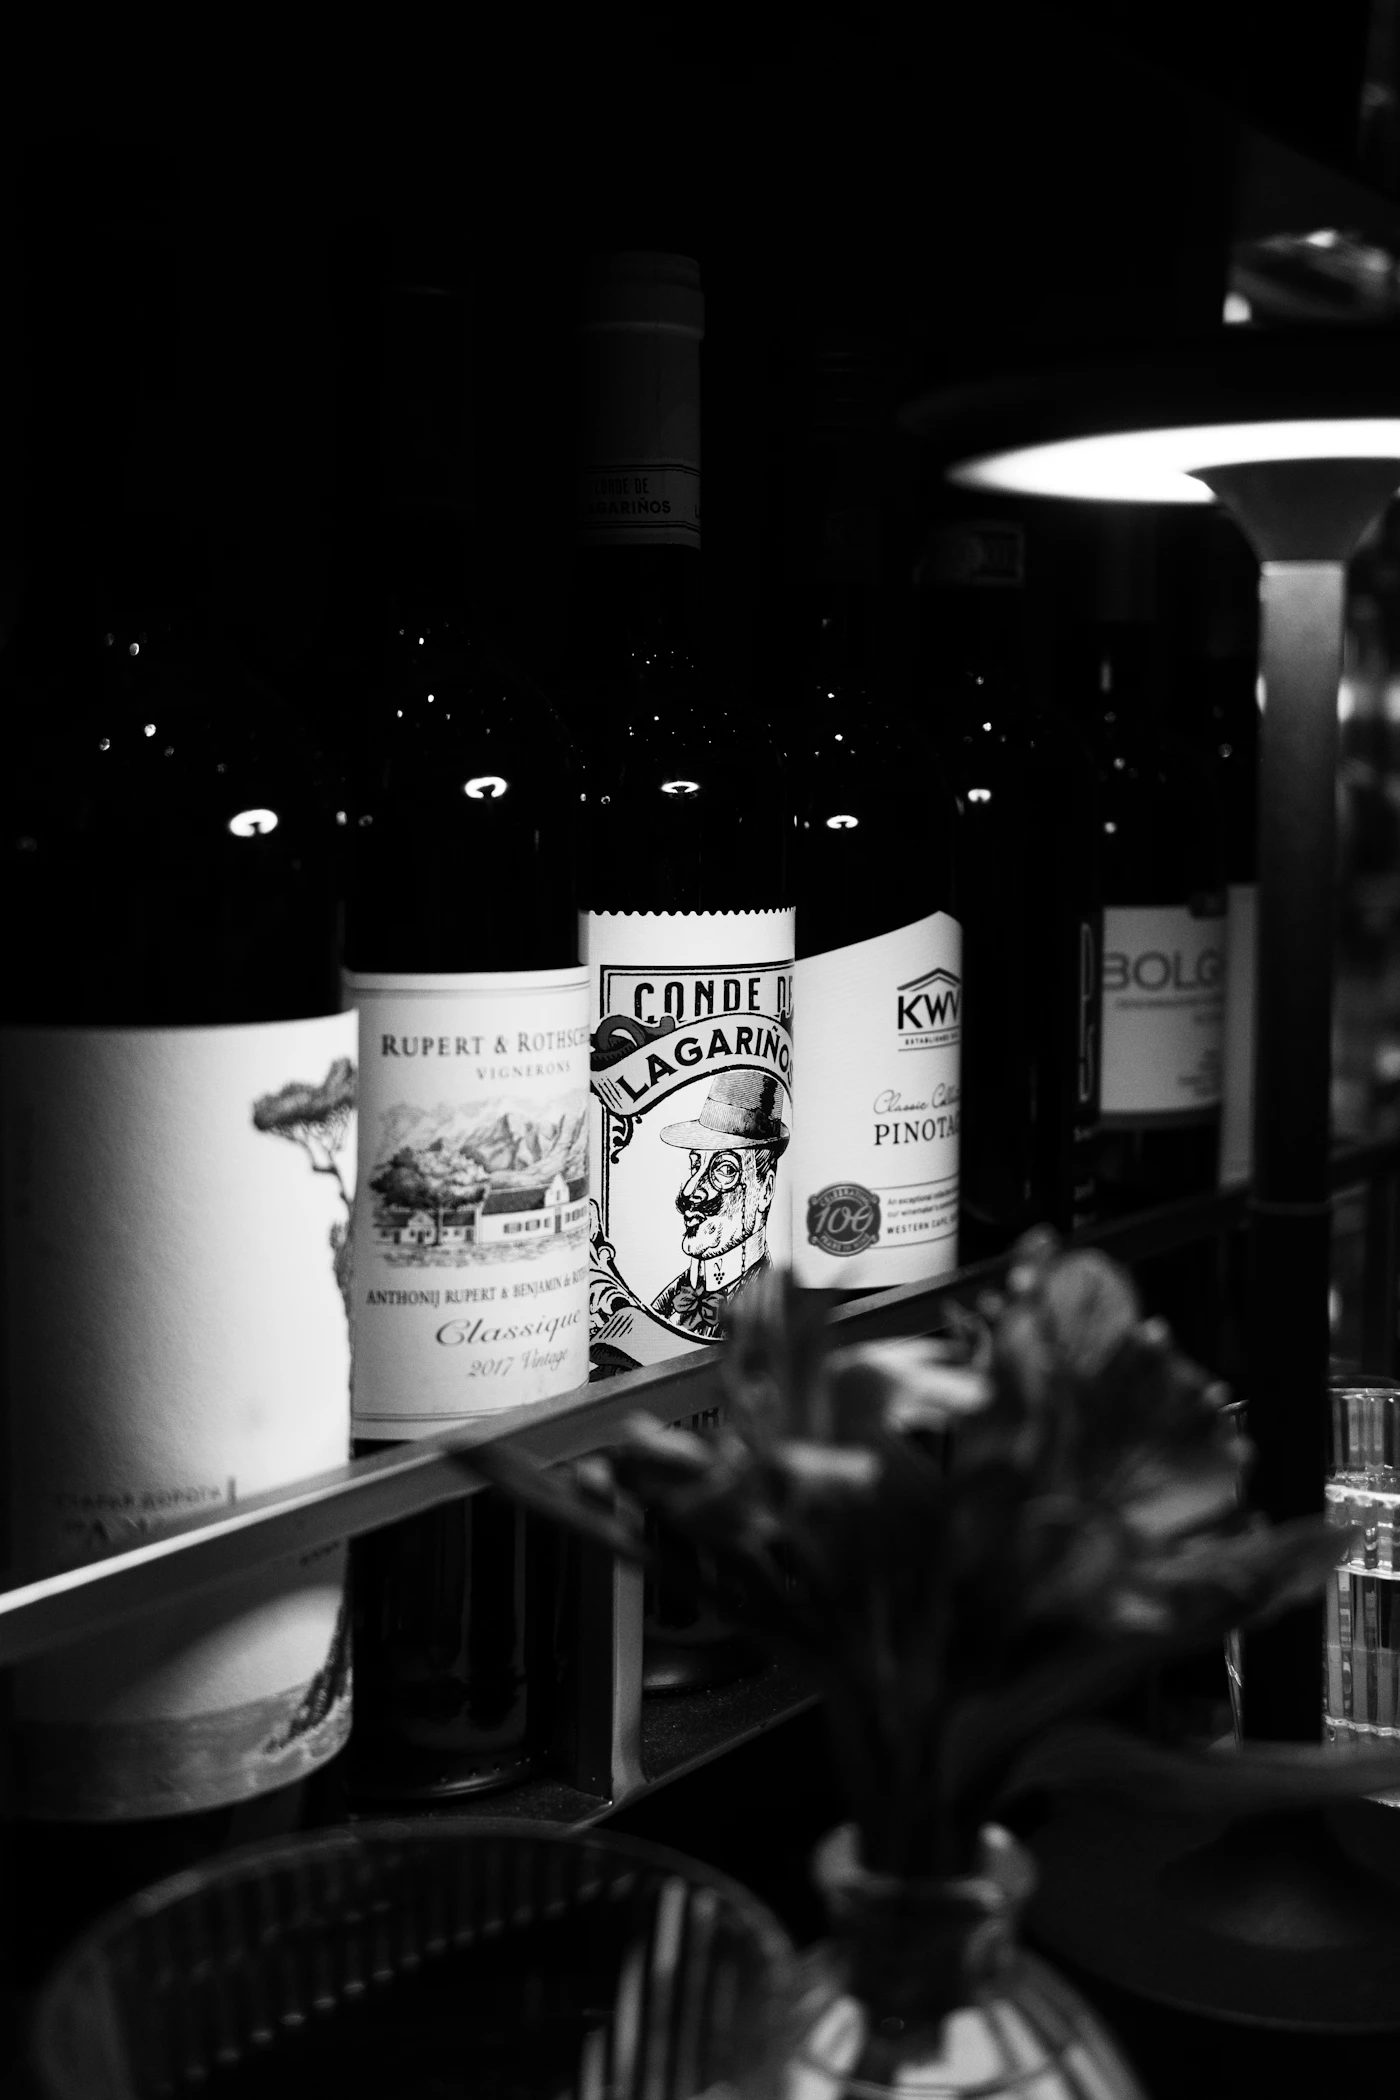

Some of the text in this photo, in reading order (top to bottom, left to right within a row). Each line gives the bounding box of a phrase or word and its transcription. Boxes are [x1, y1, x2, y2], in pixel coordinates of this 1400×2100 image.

[635, 478, 649, 494] DE
[588, 497, 671, 514] AGARIÑOS
[634, 977, 761, 1024] CONDE
[381, 1033, 485, 1057] RUPERT
[493, 1034, 508, 1054] &
[475, 1060, 571, 1081] VIGNERONS
[615, 1025, 794, 1103] LAGARIÑOS
[873, 1089, 929, 1114] Classic
[813, 1204, 876, 1234] 100
[366, 1288, 440, 1308] ANTHONIJ
[445, 1286, 497, 1304] RUPERT
[501, 1285, 510, 1300] &
[513, 1275, 562, 1298] BENJAMIN
[435, 1308, 581, 1348] Classique
[467, 1347, 569, 1378] 2017 Vintage
